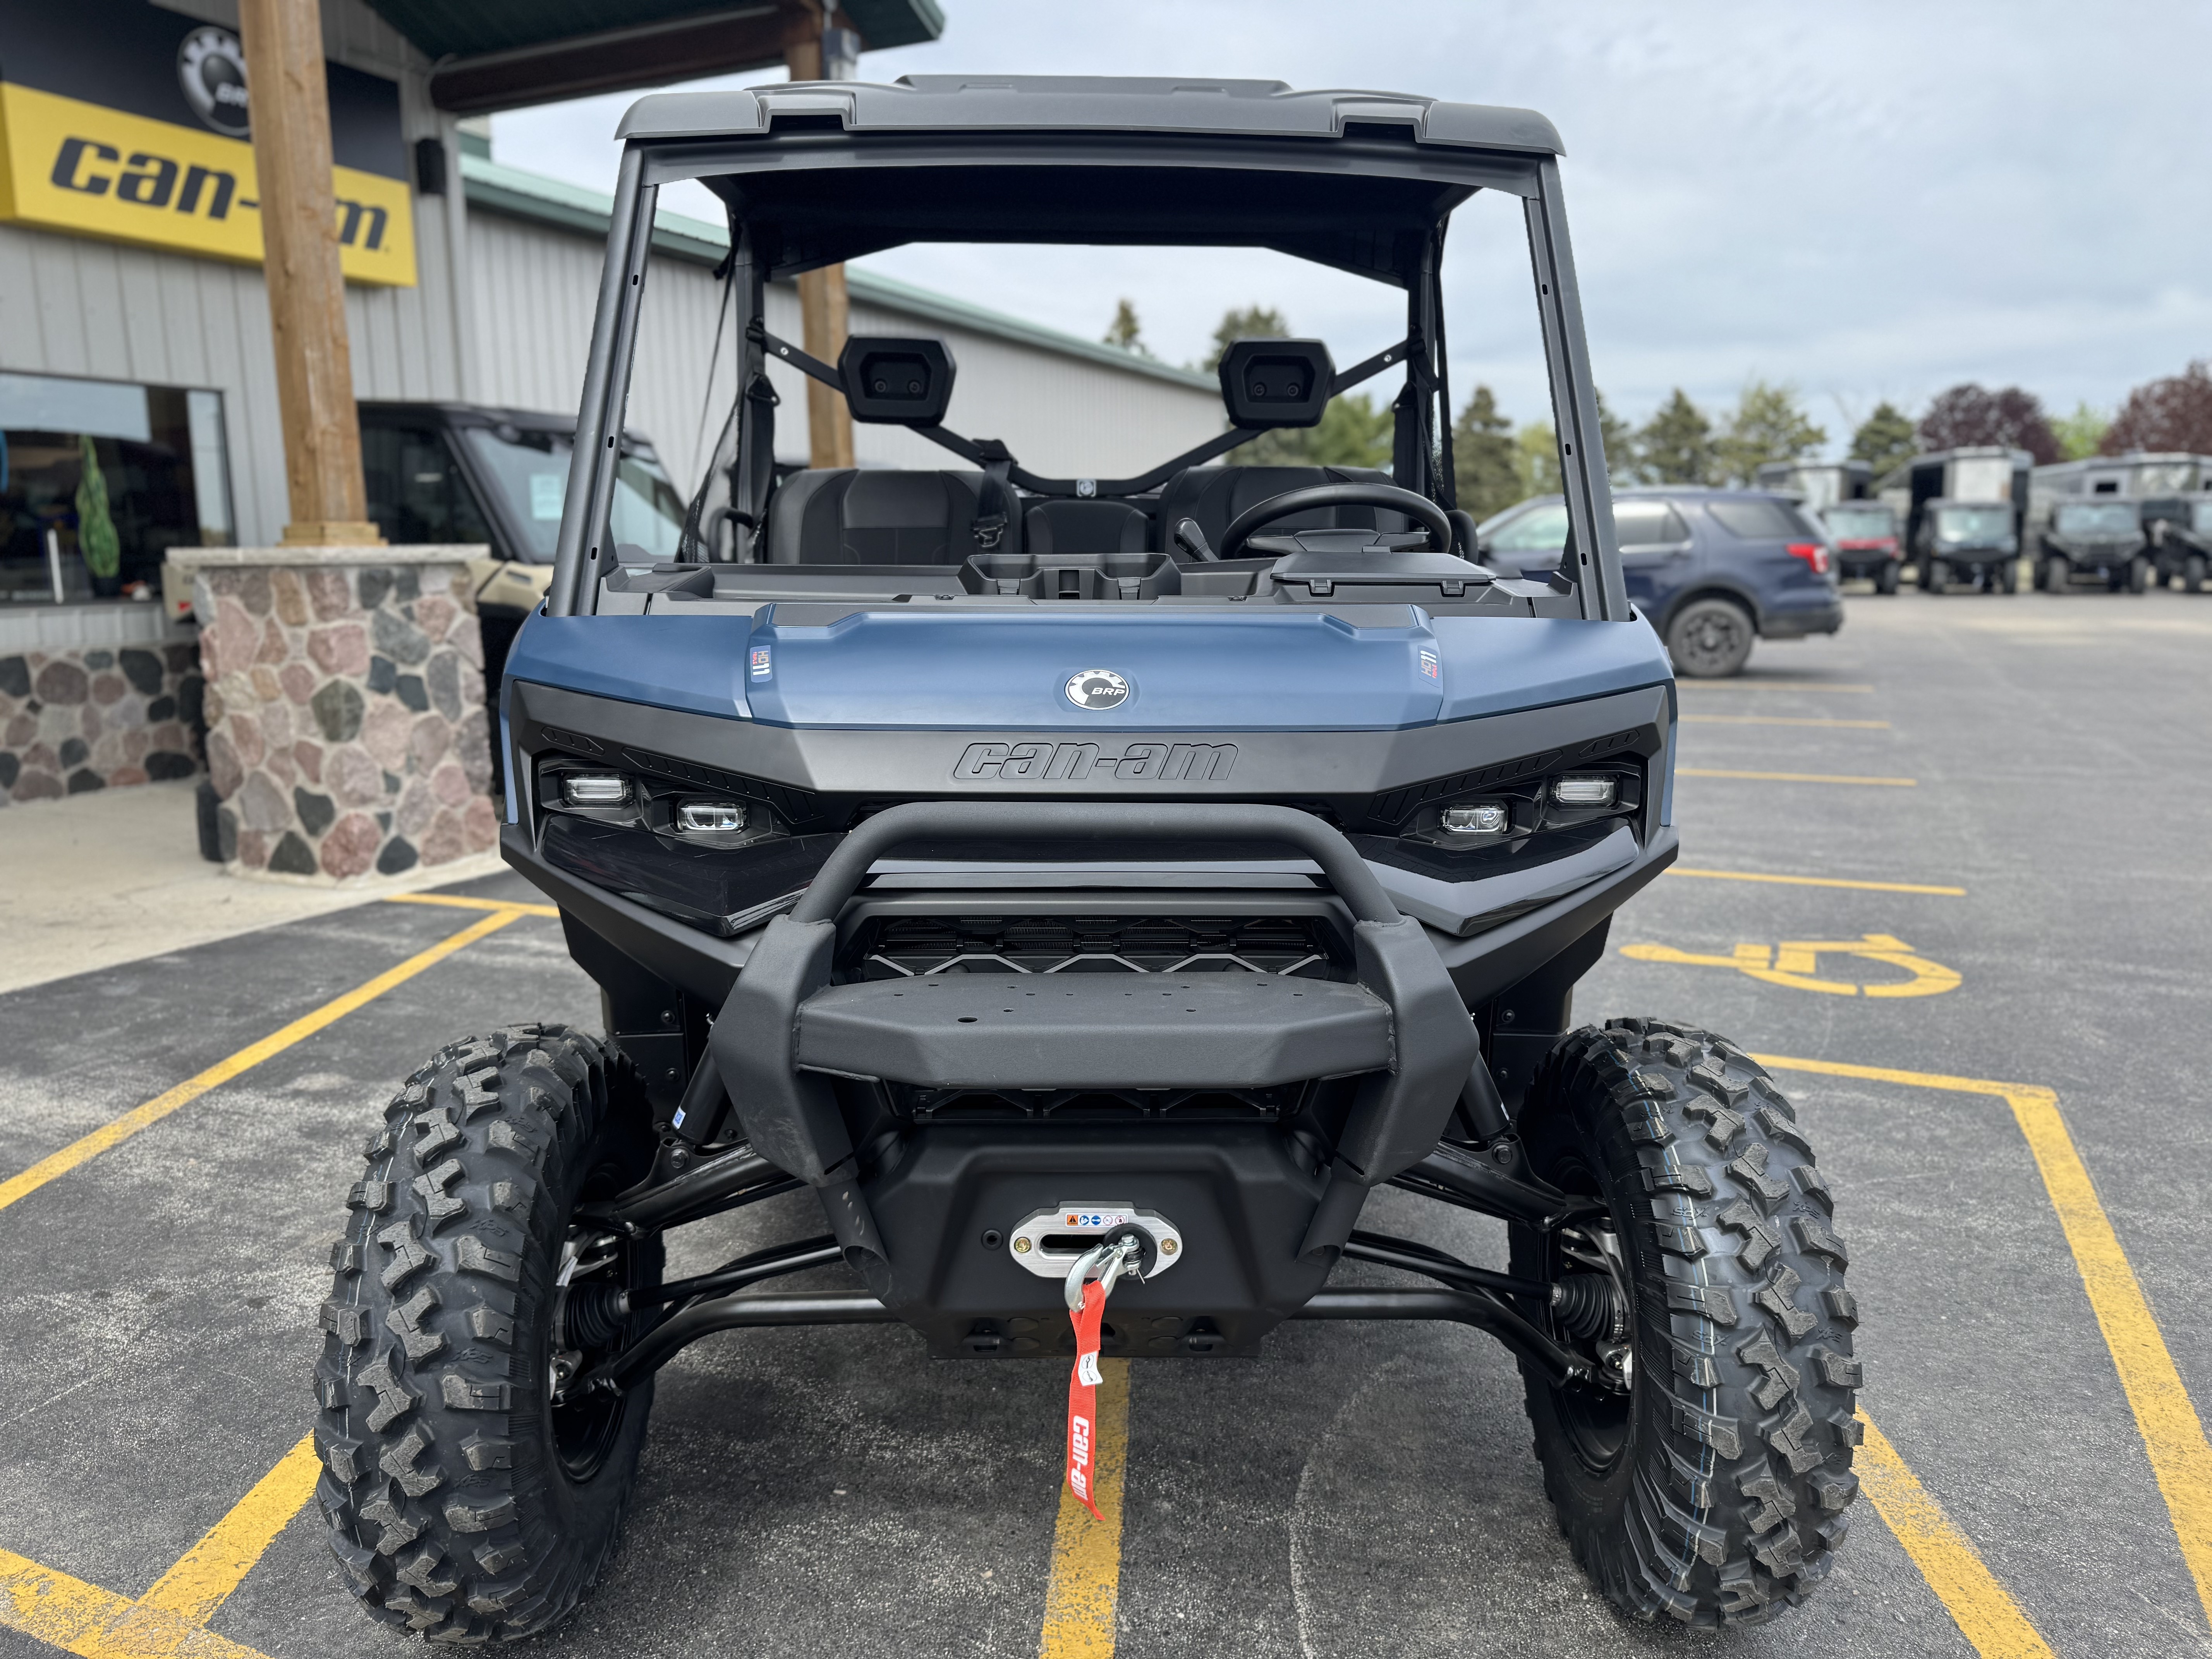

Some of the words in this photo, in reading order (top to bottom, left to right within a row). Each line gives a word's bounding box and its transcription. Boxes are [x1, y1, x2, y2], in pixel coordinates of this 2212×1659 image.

[50, 136, 388, 251] can-m
[753, 651, 770, 675] HD11
[1420, 650, 1437, 677] HD11
[1091, 687, 1125, 696] BRP
[953, 742, 1238, 780] can-am
[1071, 1415, 1089, 1501] can-am
